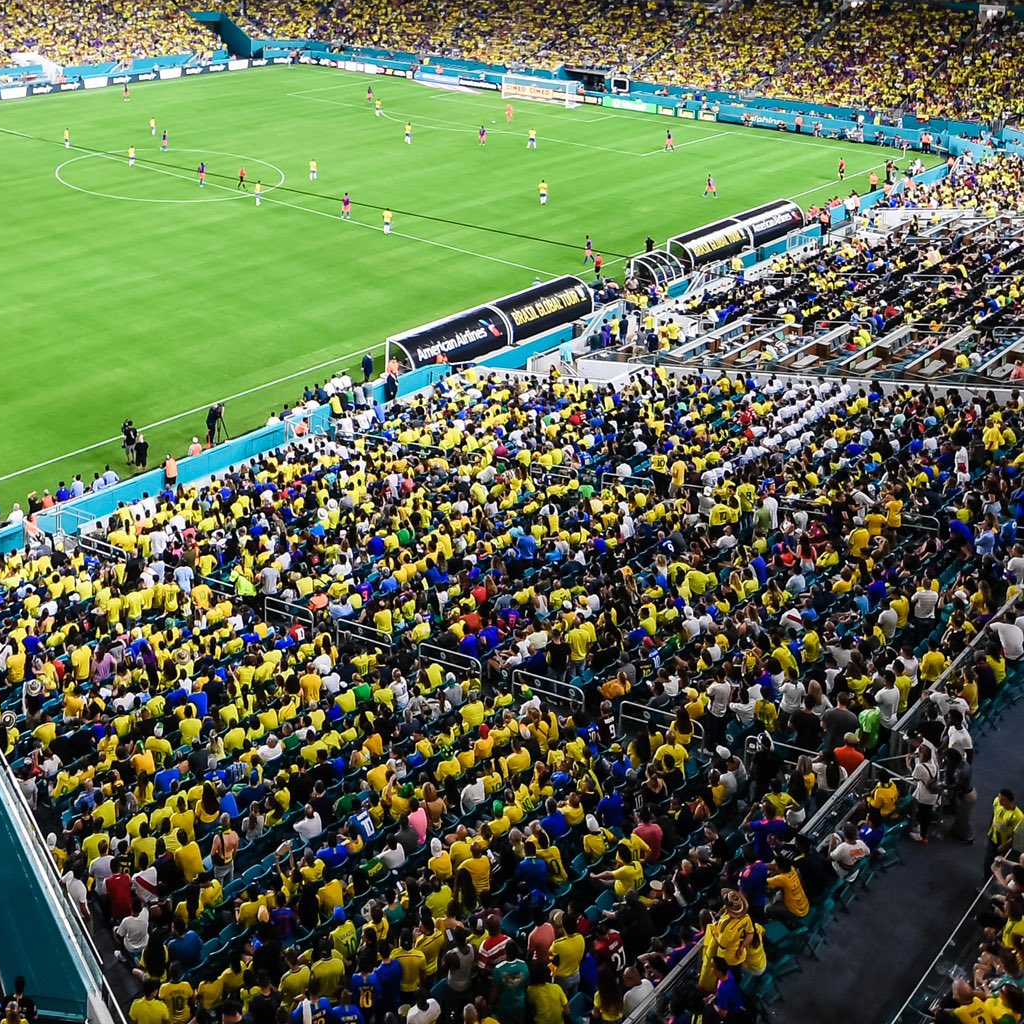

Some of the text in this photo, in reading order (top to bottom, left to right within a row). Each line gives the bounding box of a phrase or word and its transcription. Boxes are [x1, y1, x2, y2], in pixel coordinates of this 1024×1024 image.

[537, 294, 564, 317] GLOBAL
[562, 289, 581, 309] TOUR
[417, 327, 488, 362] American Airlines
[657, 459, 666, 467] 10
[667, 542, 675, 553] 9
[362, 591, 368, 602] 9
[294, 627, 306, 641] 10
[358, 663, 367, 676] 10
[155, 701, 164, 714] 10
[609, 724, 616, 739] 9
[361, 816, 375, 837] 10
[611, 946, 627, 972] 27
[171, 996, 184, 1011] 10
[360, 989, 373, 1008] 10
